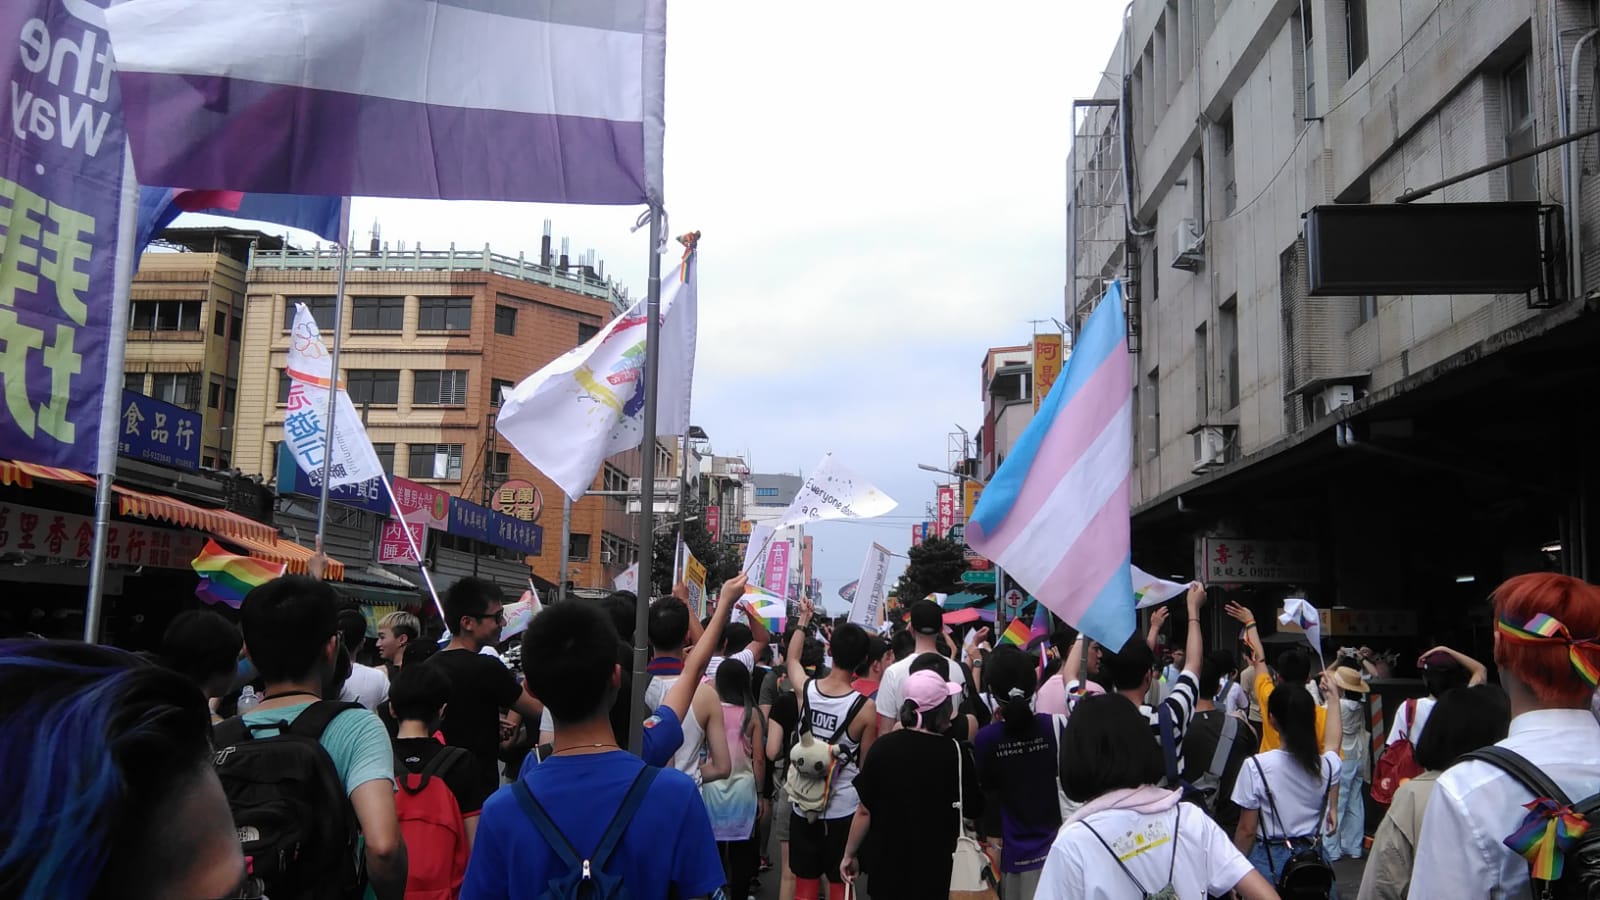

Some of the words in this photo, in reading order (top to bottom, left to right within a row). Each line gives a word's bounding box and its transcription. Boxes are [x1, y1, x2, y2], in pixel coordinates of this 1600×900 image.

[122, 401, 194, 451] 食品行
[499, 487, 534, 504] 宜蘭
[811, 711, 836, 730] LOVE
